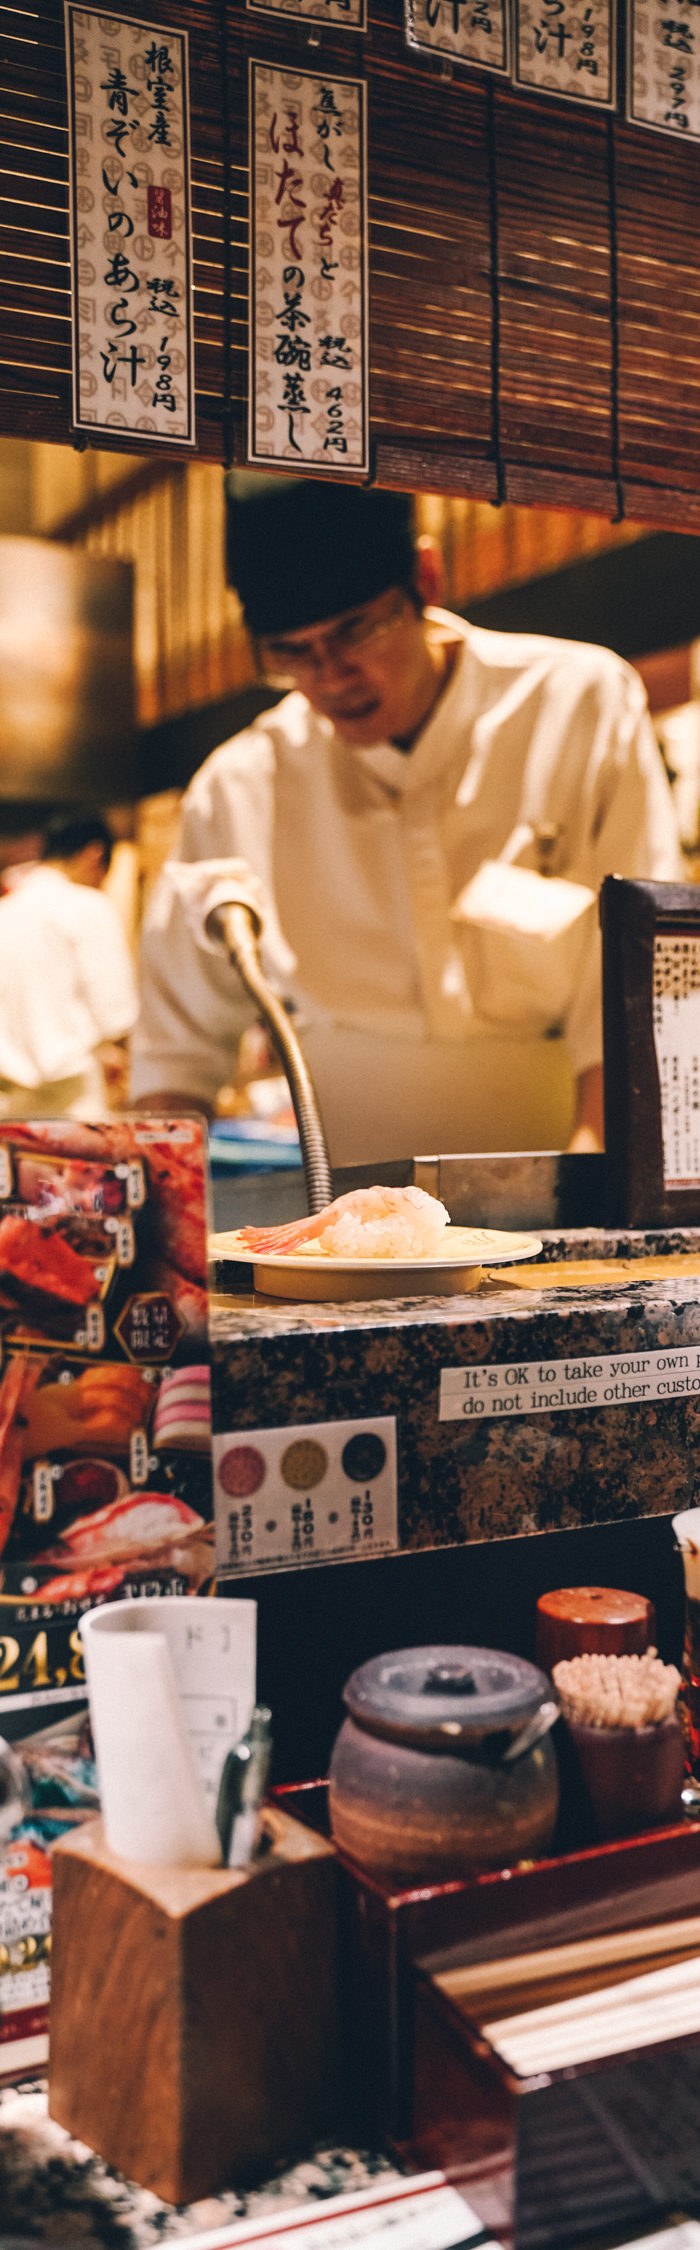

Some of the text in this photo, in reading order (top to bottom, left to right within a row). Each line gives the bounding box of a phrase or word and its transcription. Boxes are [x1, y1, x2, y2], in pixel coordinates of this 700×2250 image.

[576, 8, 599, 76] 198円
[145, 41, 174, 147] 根室産
[100, 67, 146, 388] 青ぞいのあら汁
[146, 277, 180, 318] 税込
[152, 336, 177, 412] 198円
[318, 335, 352, 370] 税込
[323, 386, 348, 453] 462円
[463, 1375, 700, 1414] do not include other custo
[464, 1369, 498, 1389] It's
[504, 1367, 530, 1385] OK
[538, 1366, 557, 1383] to
[564, 1362, 603, 1380] take
[609, 1360, 650, 1377] your
[656, 1354, 689, 1370] own
